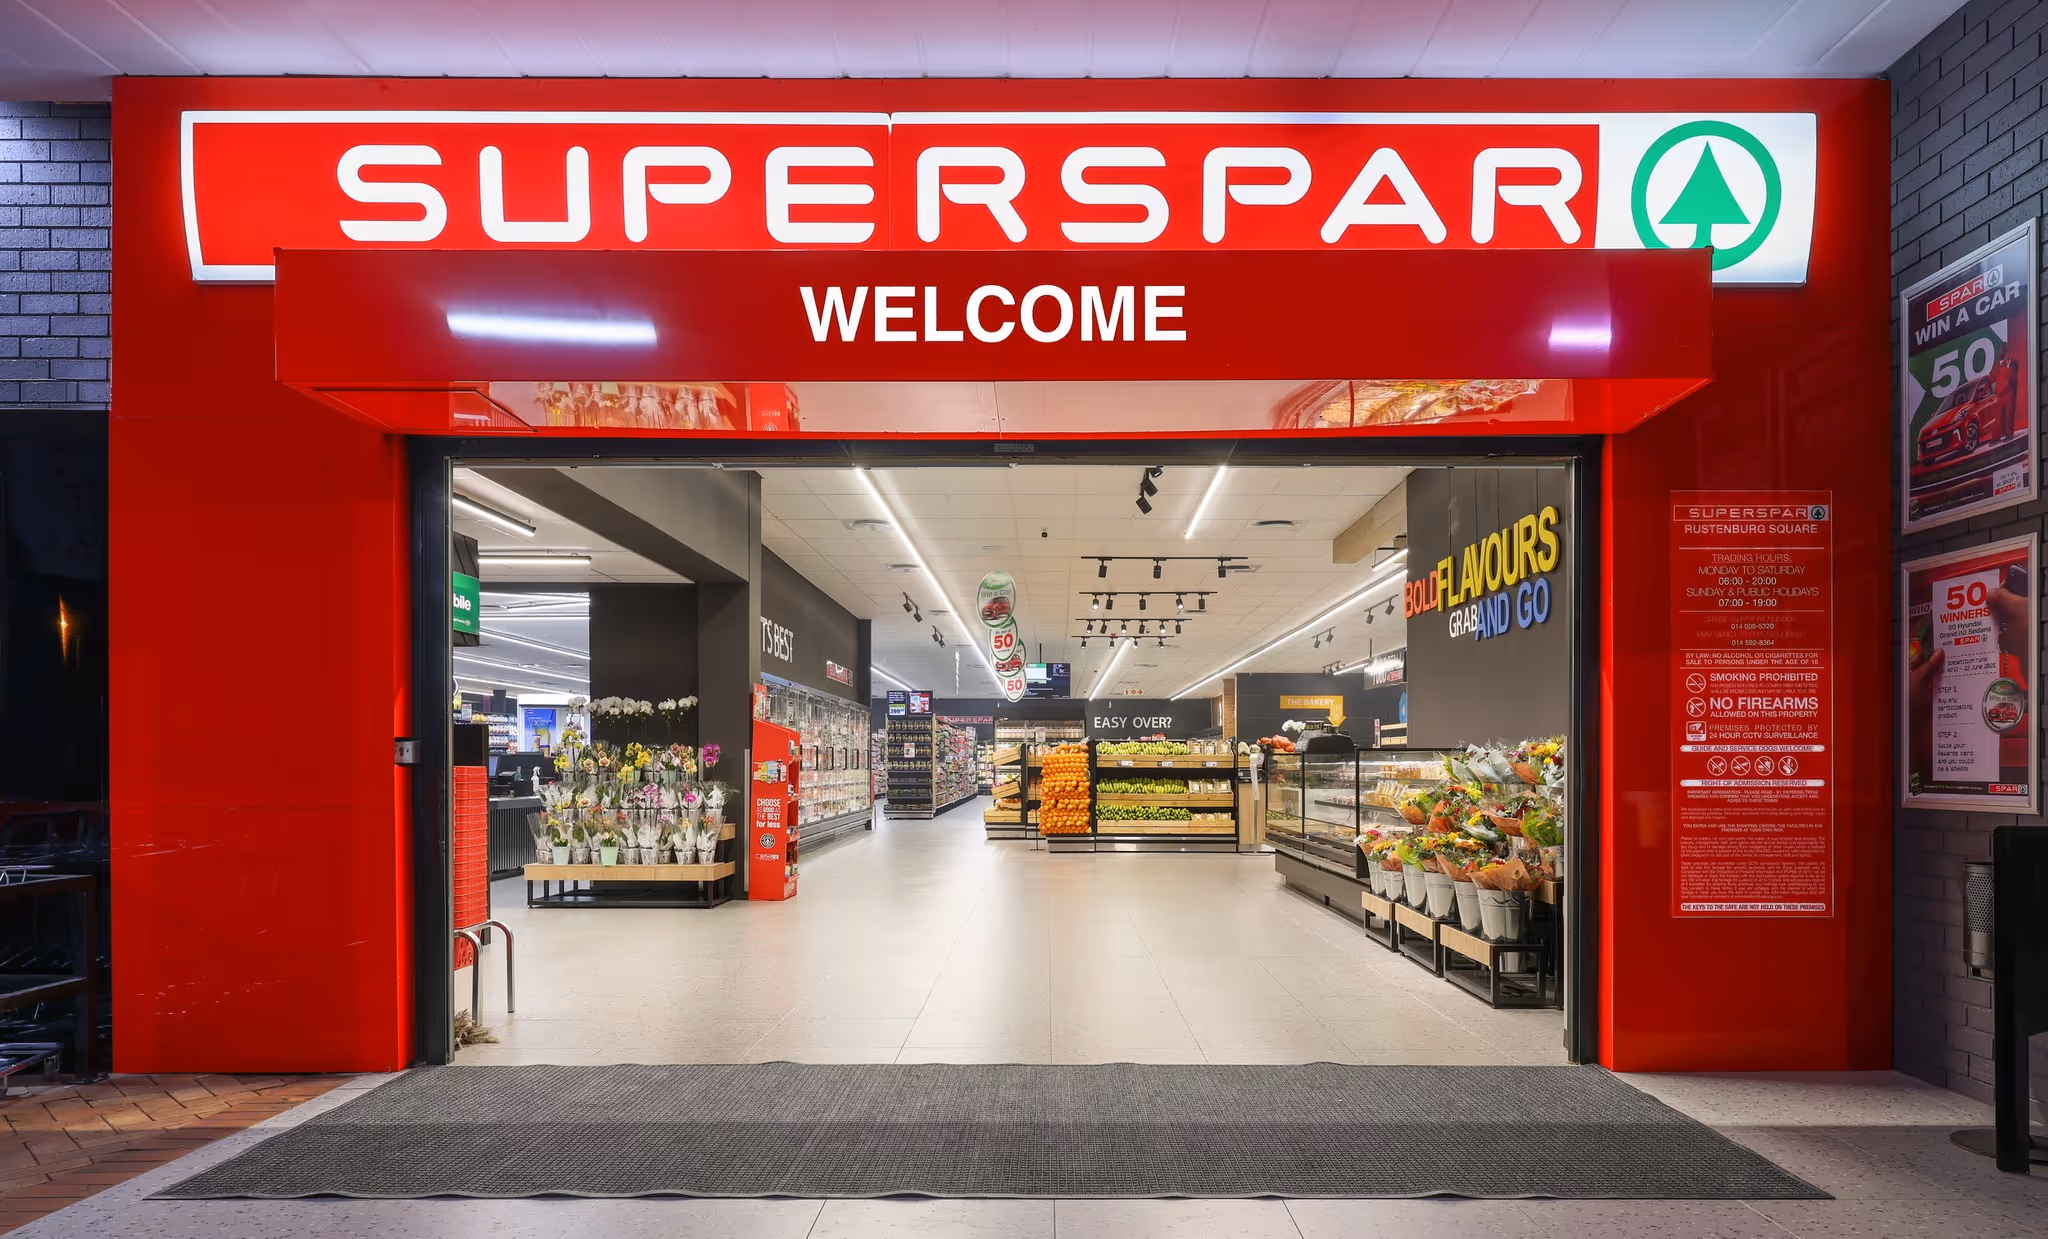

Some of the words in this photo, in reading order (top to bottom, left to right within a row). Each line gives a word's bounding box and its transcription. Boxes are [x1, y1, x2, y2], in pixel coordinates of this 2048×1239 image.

[336, 145, 1583, 244] SUPERSPAR
[1940, 279, 1984, 311] SPAR
[800, 284, 1187, 344] WELCOME
[1915, 315, 1950, 346] WIN
[1955, 307, 1970, 327] A
[1975, 281, 2020, 316] CAR
[1931, 338, 1995, 398] 50
[1689, 508, 1807, 518] SUPERSPAR
[1684, 524, 1766, 534] RUSTENBURG
[1769, 524, 1818, 534] SQUARE
[1437, 506, 1560, 612] FLAVOURS
[1712, 553, 1753, 562] TRADING
[1755, 553, 1792, 562] HOURS:
[1698, 566, 1739, 575] MONDAY
[1743, 566, 1755, 575] TO
[1757, 566, 1806, 575] SATURDAY
[1718, 577, 1743, 586] 06:00
[1751, 577, 1777, 586] 20:00
[1404, 570, 1438, 619] BOLD
[1686, 587, 1725, 597] SUNDAY
[1728, 587, 1735, 597] &
[1737, 587, 1770, 597] PUBLIC
[1773, 587, 1819, 597] HOLIDAYS
[1946, 581, 1987, 610] 50
[1449, 604, 1478, 638] GRAB
[1475, 591, 1511, 641] AND
[1517, 577, 1550, 629] GO
[1718, 598, 1743, 607] 07:00
[1753, 598, 1777, 607] 19:00
[1940, 608, 1991, 623] WINNERS
[1958, 620, 1982, 631] Hyundai
[1940, 630, 1957, 639] Grand
[1968, 626, 1992, 636] Sedans
[774, 623, 794, 663] BEST
[993, 633, 1014, 650] 50
[1960, 636, 1980, 645] SPAR
[1710, 673, 1756, 682] SMOKING
[1759, 673, 1818, 682] PROHIBITED
[1007, 679, 1022, 691] 50
[1287, 698, 1302, 706] THE
[1303, 698, 1335, 706] BAKERY
[1710, 697, 1733, 710] NO
[1738, 697, 1818, 710] FIREARMS
[1094, 716, 1128, 729] EASY
[1132, 716, 1173, 729] OVER?
[756, 798, 781, 807] CHOOSE
[756, 820, 766, 828] for
